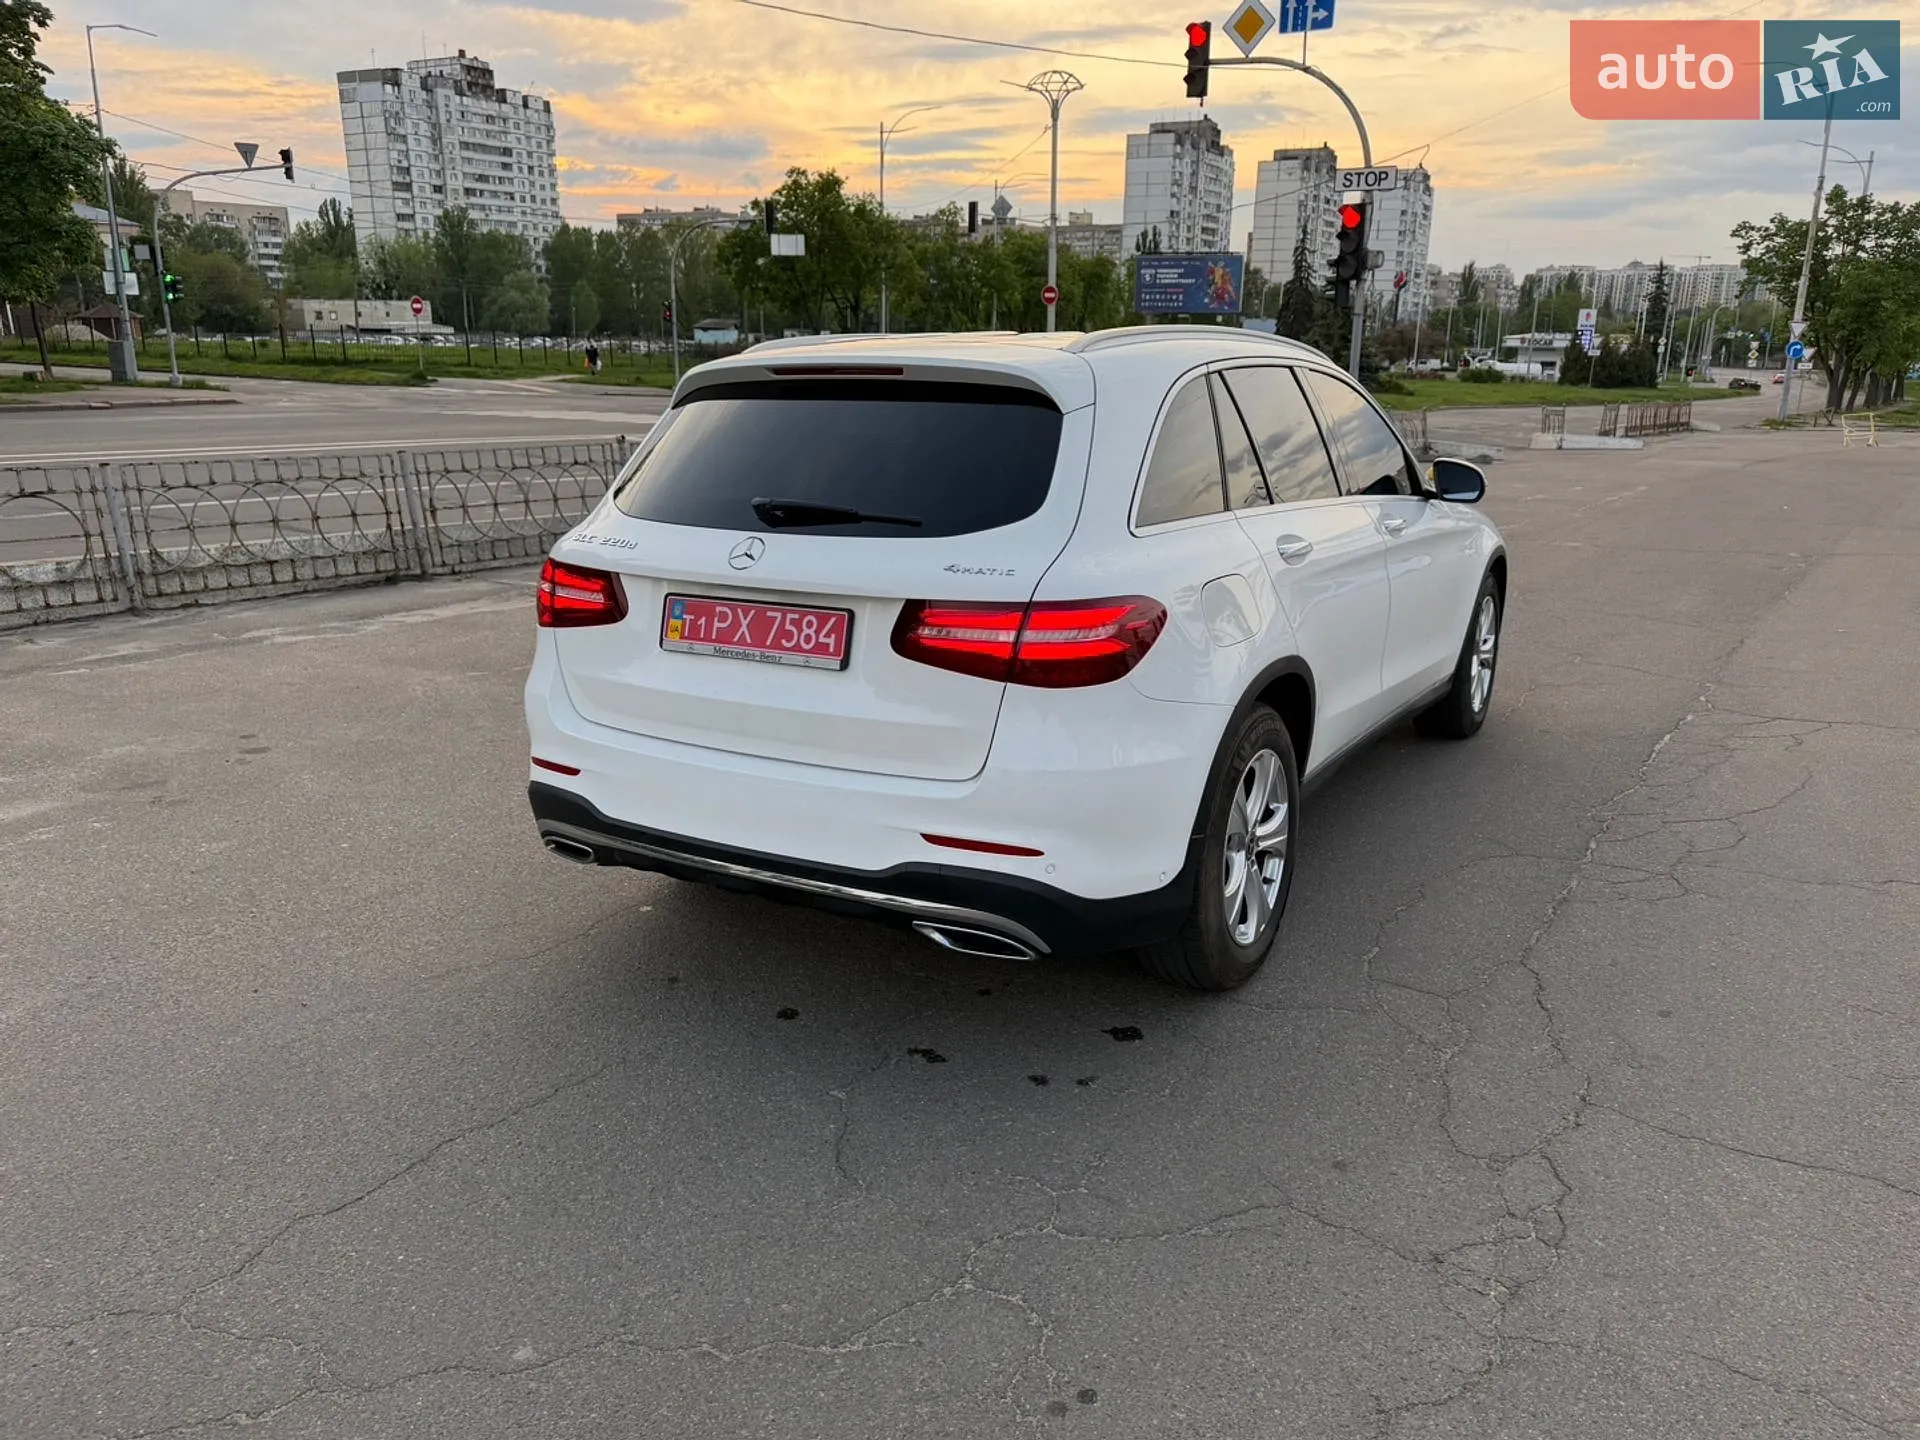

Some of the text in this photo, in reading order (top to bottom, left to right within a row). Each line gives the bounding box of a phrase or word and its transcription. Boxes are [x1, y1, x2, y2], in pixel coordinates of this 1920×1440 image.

[1342, 171, 1389, 188] STOP
[600, 536, 638, 549] 220d
[766, 611, 836, 652] 7584
[713, 646, 783, 662] Mercedes-Benz
